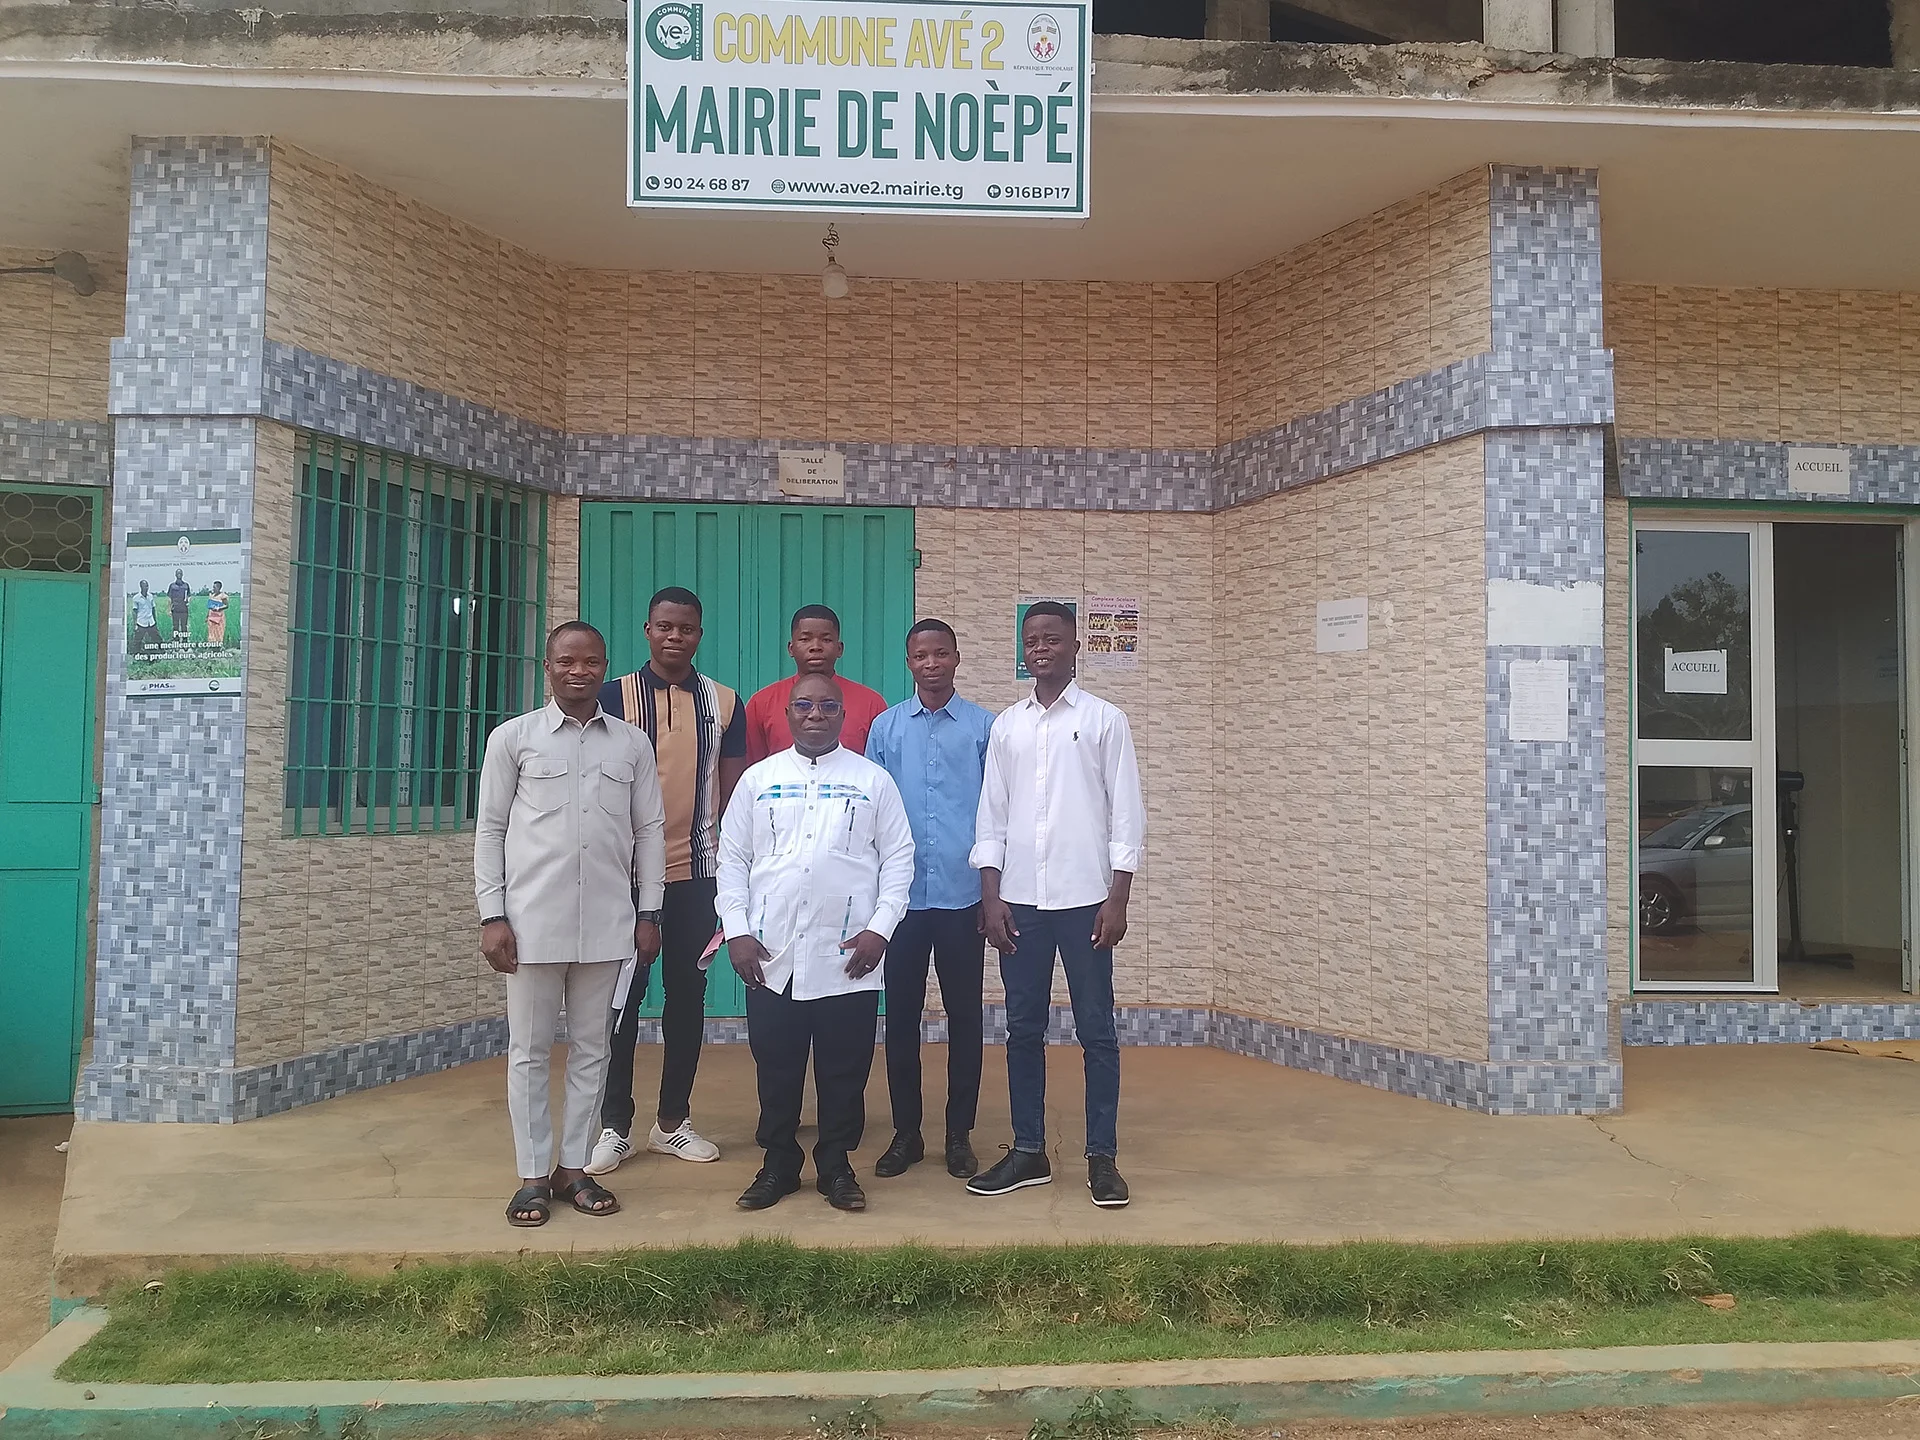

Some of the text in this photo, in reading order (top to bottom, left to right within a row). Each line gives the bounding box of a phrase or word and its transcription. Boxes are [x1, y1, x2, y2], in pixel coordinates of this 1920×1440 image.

[657, 6, 692, 17] COMMUNE
[713, 10, 1005, 71] COMMUNE AVÉ 2
[645, 80, 1073, 163] MAIRIE DE NOÈPÉ
[663, 177, 750, 191] 90 24 68 87
[787, 180, 964, 200] www.ave2.mairie.tg
[1004, 186, 1070, 199] 916BP17
[1795, 461, 1843, 472] ACCUEIL
[173, 630, 192, 638] Pour
[160, 641, 196, 649] meilleure
[149, 652, 196, 662] producteurs
[198, 651, 233, 660] agricoles
[1671, 662, 1720, 673] ACCUEIL
